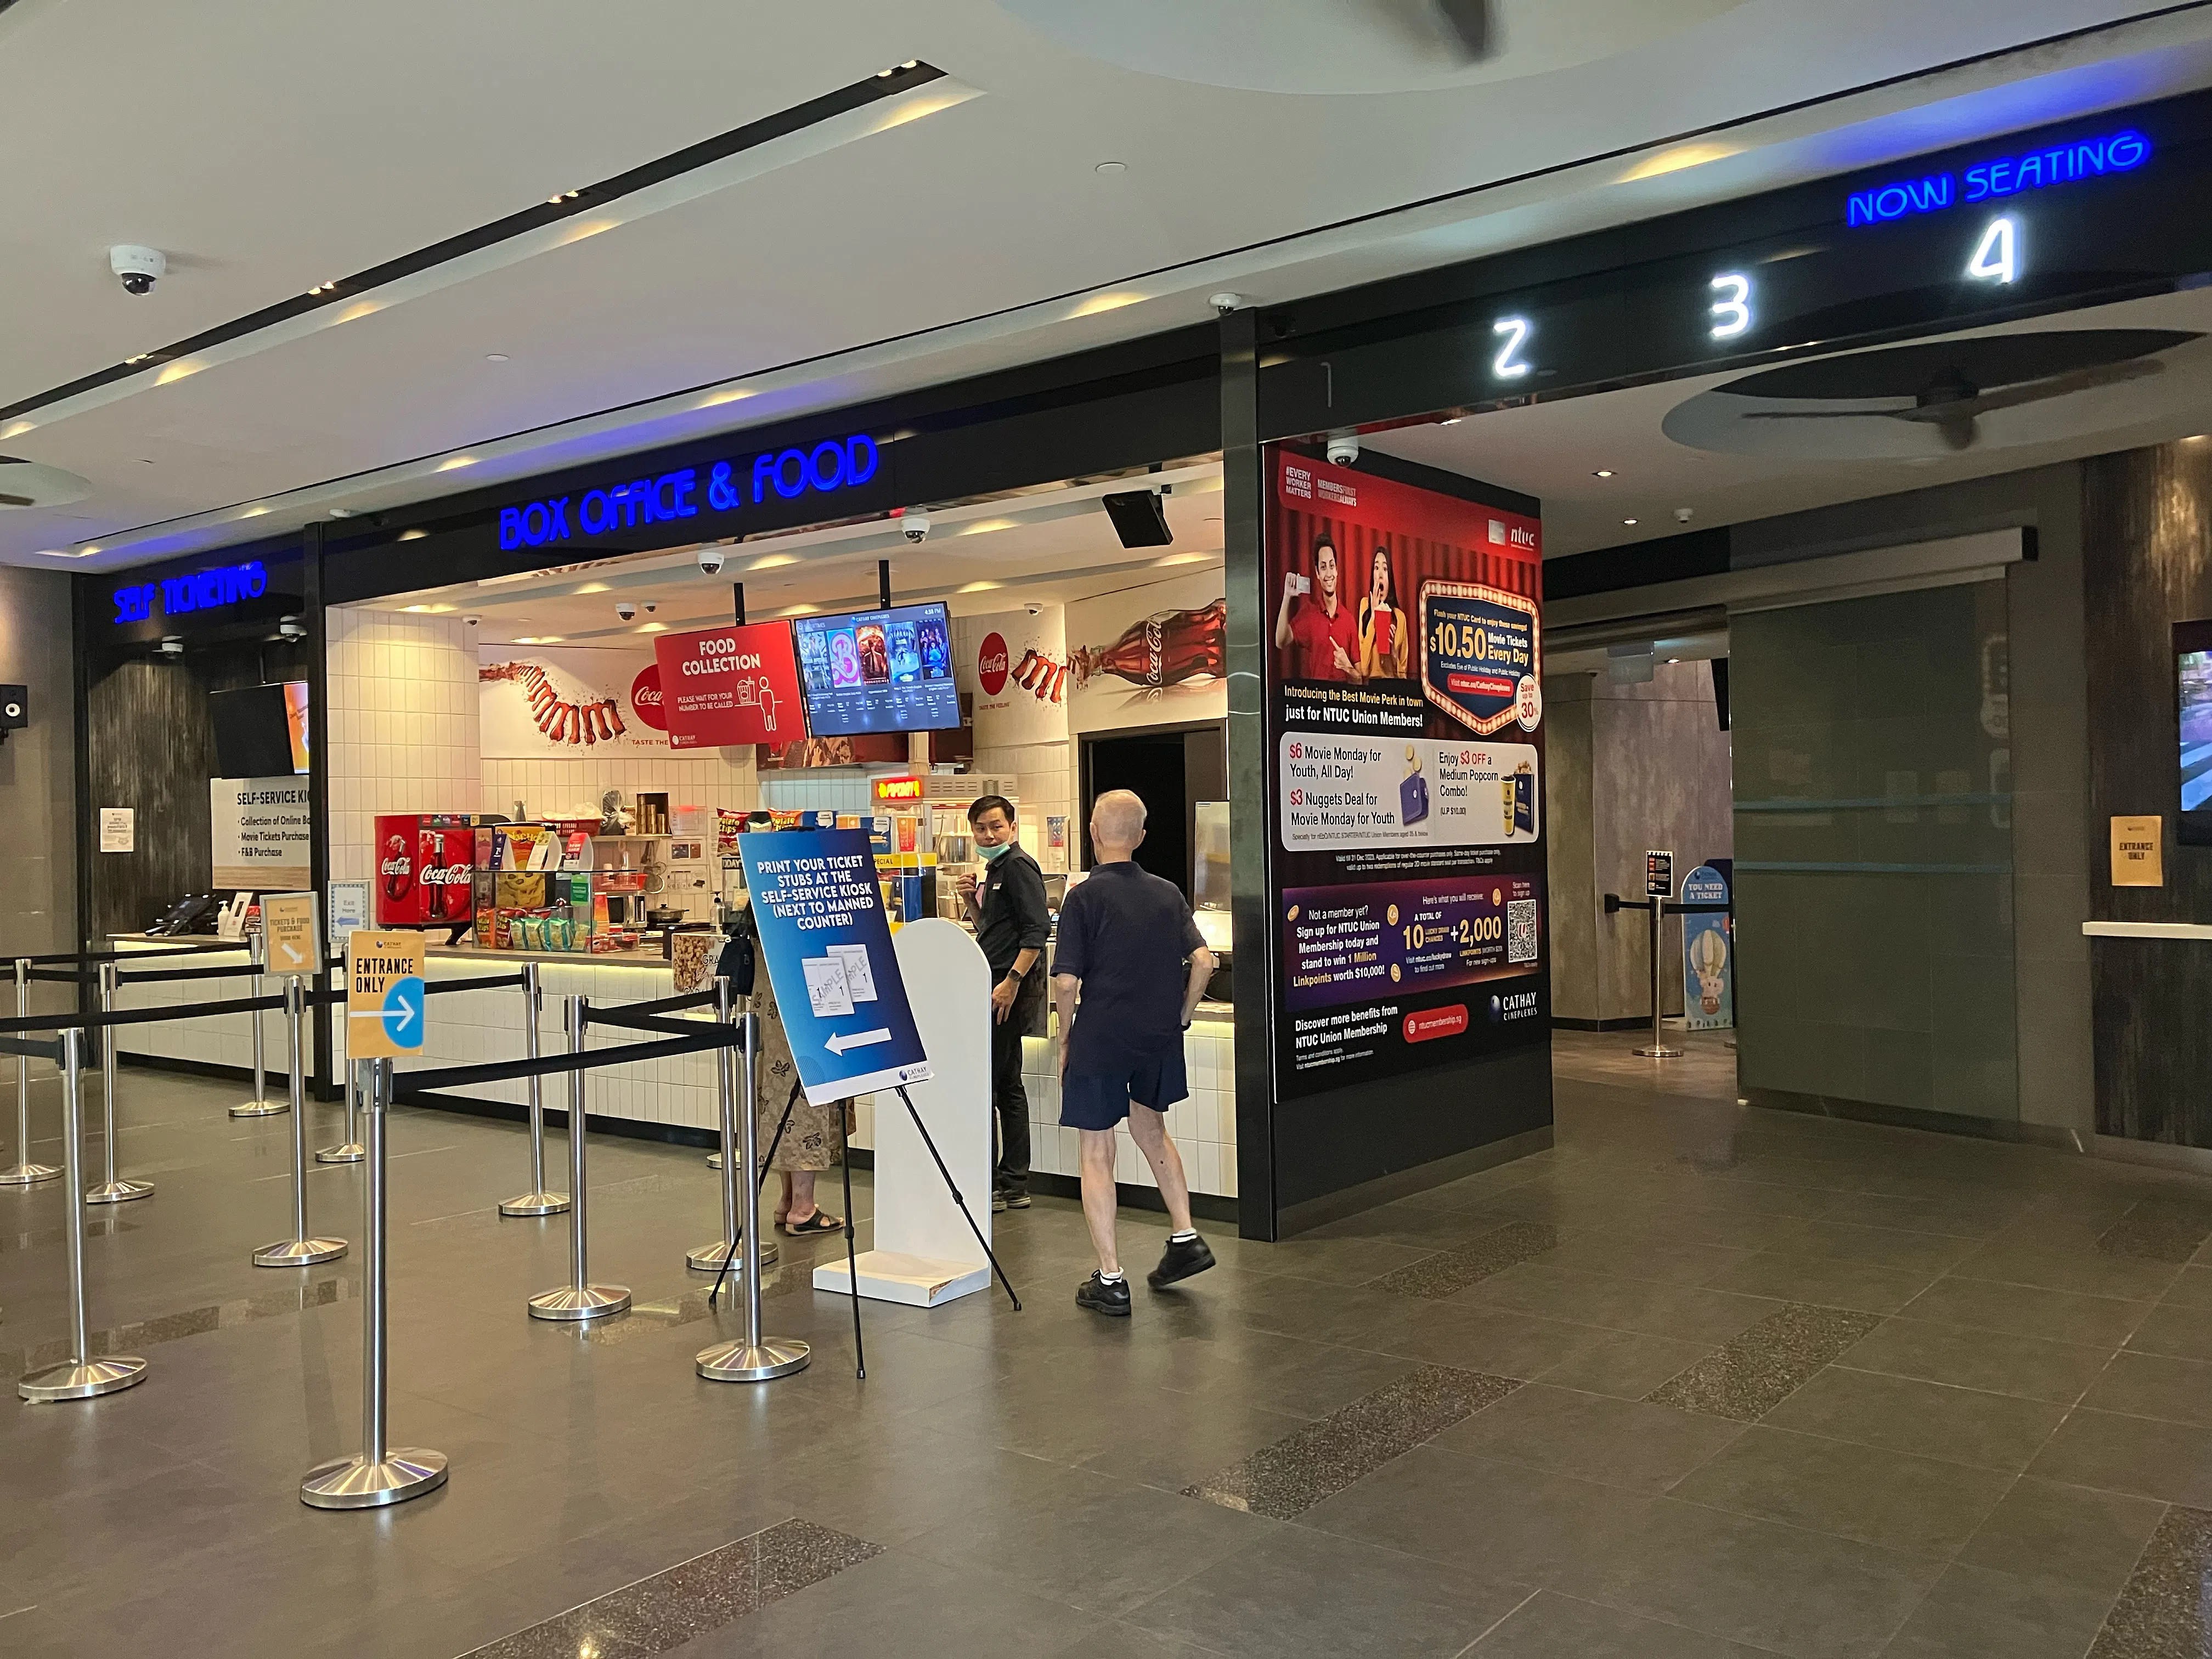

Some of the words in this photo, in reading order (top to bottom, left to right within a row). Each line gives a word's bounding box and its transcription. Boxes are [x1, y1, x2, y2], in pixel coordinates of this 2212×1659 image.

[1848, 174, 1951, 227] NOW
[1965, 133, 2146, 201] SEATING
[1970, 219, 2014, 283] 4
[1712, 275, 1750, 337] 3
[1493, 319, 1527, 376] 2
[1285, 476, 1311, 490] WORKER
[500, 496, 571, 550] BOX
[579, 469, 699, 535] OFFICE
[709, 461, 741, 511] &
[753, 435, 878, 504] FOOD
[1285, 486, 1311, 499] MATTERS
[1510, 527, 1534, 546] ntuc
[114, 583, 156, 624] SELF
[1457, 613, 1470, 622] NTUC
[1471, 615, 1481, 624] Card
[699, 638, 736, 656] FOOD
[1430, 622, 1486, 661] $10.50
[1488, 632, 1505, 645] Movie
[1506, 635, 1528, 648] Tickets
[1146, 620, 1163, 685] Coca-Col
[1488, 645, 1511, 665] Every
[1513, 648, 1529, 667] Day
[682, 653, 761, 676] COLLECTION
[980, 652, 1007, 674] Coca-Cola
[635, 686, 665, 706] Coca
[1284, 685, 1327, 702] Introducing
[1329, 689, 1340, 701] the
[1342, 690, 1358, 703] Best
[1360, 691, 1380, 704] Movie
[1382, 693, 1397, 706] Perk
[1399, 695, 1405, 706] in
[1406, 697, 1424, 707] town
[1520, 683, 1534, 692] Save
[1285, 704, 1305, 721] just
[1307, 706, 1321, 721] for
[1323, 707, 1350, 723] NTUC
[1352, 709, 1378, 724] Union
[1380, 712, 1423, 727] Members!
[1289, 742, 1302, 759] $6
[1305, 746, 1331, 759] Movie
[1334, 747, 1368, 763] Monday
[1369, 748, 1381, 761] for
[1439, 752, 1459, 766] Enjoy
[1460, 750, 1470, 765] $3
[1472, 753, 1486, 765] OFF
[1487, 757, 1492, 765] a
[1290, 763, 1319, 780] Youth,
[1321, 765, 1332, 778] All
[1335, 765, 1353, 781] Day!
[1440, 769, 1468, 780] Medium
[1470, 769, 1498, 783] Popcorn
[237, 791, 296, 805] SELF-SERVICE
[1290, 788, 1303, 805] $3
[1305, 792, 1342, 808] Nuggets
[1345, 792, 1363, 805] Deal
[1365, 793, 1378, 805] for
[1440, 785, 1468, 797] Combo!
[241, 816, 271, 826] Collection
[273, 815, 279, 825] of
[280, 815, 301, 825] Online
[1291, 812, 1318, 826] Movie
[1321, 812, 1355, 827] Monday
[1358, 811, 1369, 825] for
[1371, 811, 1395, 825] Youth
[241, 832, 258, 840] Movie
[259, 832, 280, 840] Tickets
[281, 831, 309, 840] Purchase
[241, 848, 253, 856] F&B
[254, 847, 282, 856] Purchase
[381, 857, 411, 875] Coca-Cola
[757, 860, 791, 874] PRINT
[793, 858, 826, 872] YOUR
[827, 855, 863, 868] TICKET
[420, 864, 474, 885] Coca-Cola
[777, 873, 813, 888] STUBS
[816, 872, 829, 885] AT
[831, 870, 852, 883] THE
[761, 885, 838, 904] SELF-SERVICE
[839, 882, 873, 897] KIOSK
[1423, 896, 1437, 905] Here's
[1449, 895, 1458, 904] you
[773, 903, 806, 918] (NEXT
[808, 901, 825, 914] TO
[827, 896, 874, 913] MANNED
[1308, 910, 1321, 920] Not
[1328, 907, 1354, 918] member
[1355, 905, 1368, 918] yet?
[797, 912, 854, 930] COUNTER)
[1414, 913, 1419, 922] A
[1419, 912, 1435, 921] TOTAL
[1435, 911, 1442, 919] OF
[1296, 927, 1313, 939] Sign
[1315, 927, 1324, 938] up
[1327, 924, 1337, 935] for
[1338, 922, 1358, 933] NTUC
[1360, 920, 1380, 931] Union
[1403, 924, 1424, 950] 10
[1460, 916, 1502, 947] 2,000
[1299, 939, 1344, 953] Membership
[1345, 938, 1364, 949] today
[1366, 935, 1379, 945] and
[356, 958, 413, 974] ENTRANCE
[702, 955, 719, 964] GRA
[1301, 957, 1322, 970] stand
[1324, 957, 1331, 967] to
[1333, 955, 1346, 965] win
[1348, 953, 1352, 963] 1
[1354, 951, 1376, 963] Million
[356, 977, 385, 992] ONLY
[863, 973, 867, 983] 1
[1293, 973, 1331, 988] Linkpoints
[1333, 969, 1353, 981] worth
[1355, 964, 1385, 979] $10,000!
[812, 969, 843, 1006] SAMPLE
[839, 985, 844, 996] 1
[1503, 992, 1537, 1011] CATHAY
[1295, 1018, 1329, 1031] Discover
[1330, 1015, 1350, 1025] more
[1351, 1007, 1380, 1022] benefits
[1381, 1005, 1398, 1017] from
[1503, 1007, 1537, 1021] CINEPLEXES
[1296, 1034, 1318, 1049] NTUC
[1320, 1031, 1342, 1043] Union
[1344, 1022, 1387, 1040] Membership
[907, 1066, 927, 1075] CATHAY
